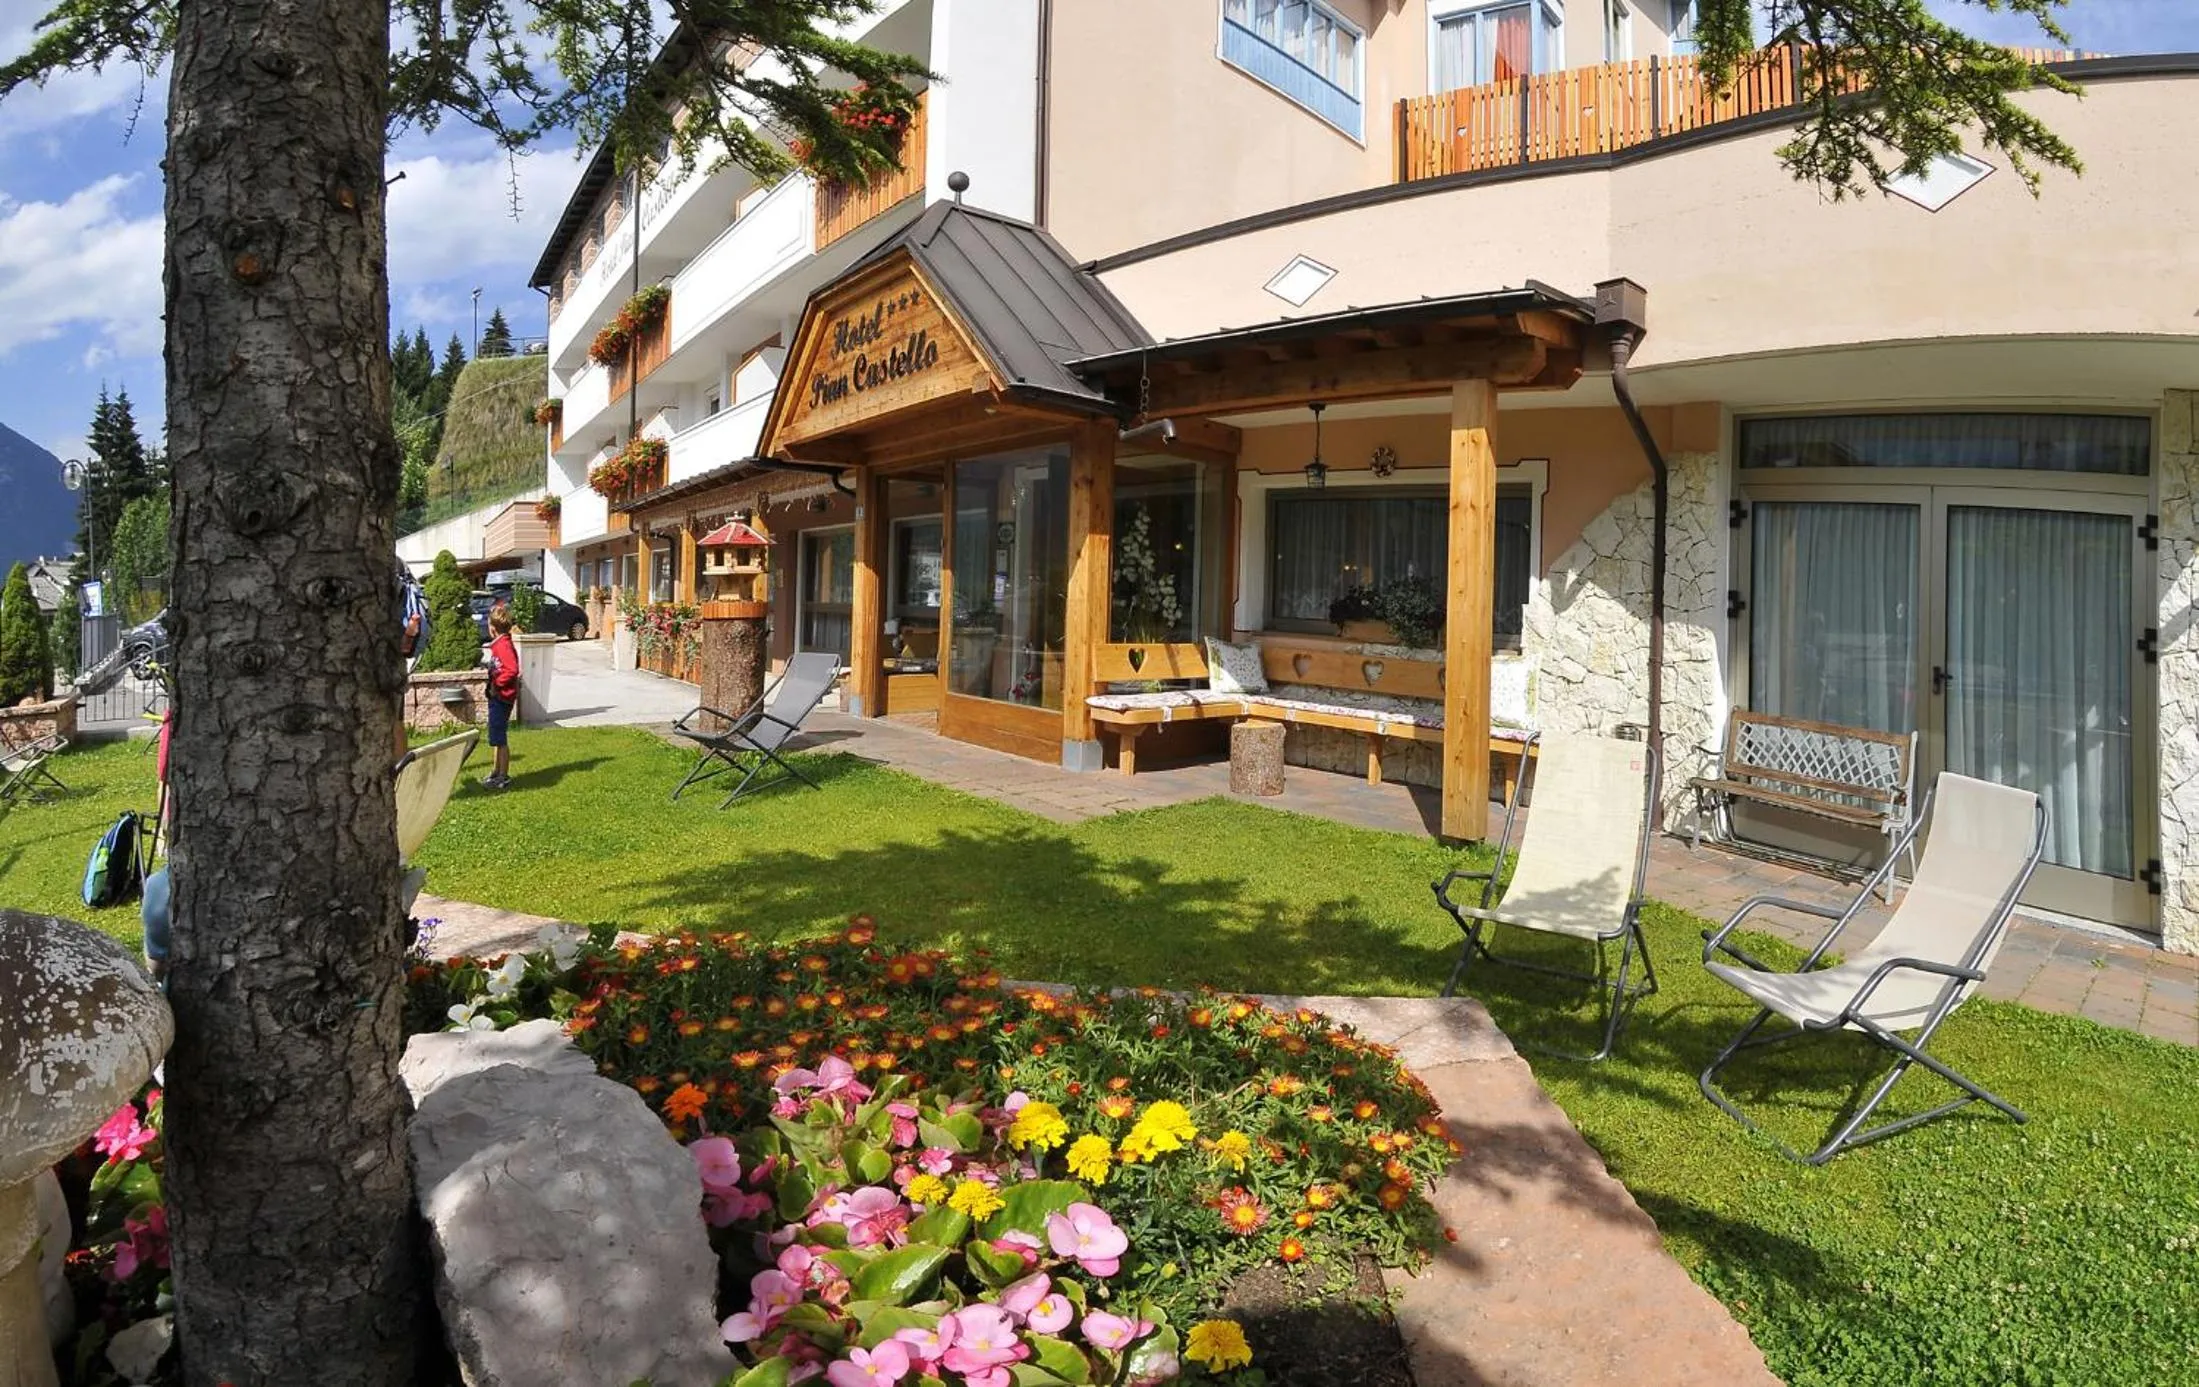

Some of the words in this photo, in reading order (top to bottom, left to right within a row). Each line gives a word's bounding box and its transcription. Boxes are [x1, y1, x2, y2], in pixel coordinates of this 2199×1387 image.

[831, 301, 884, 360] Hotel
[809, 373, 848, 409] Pian
[853, 329, 938, 392] Castello
